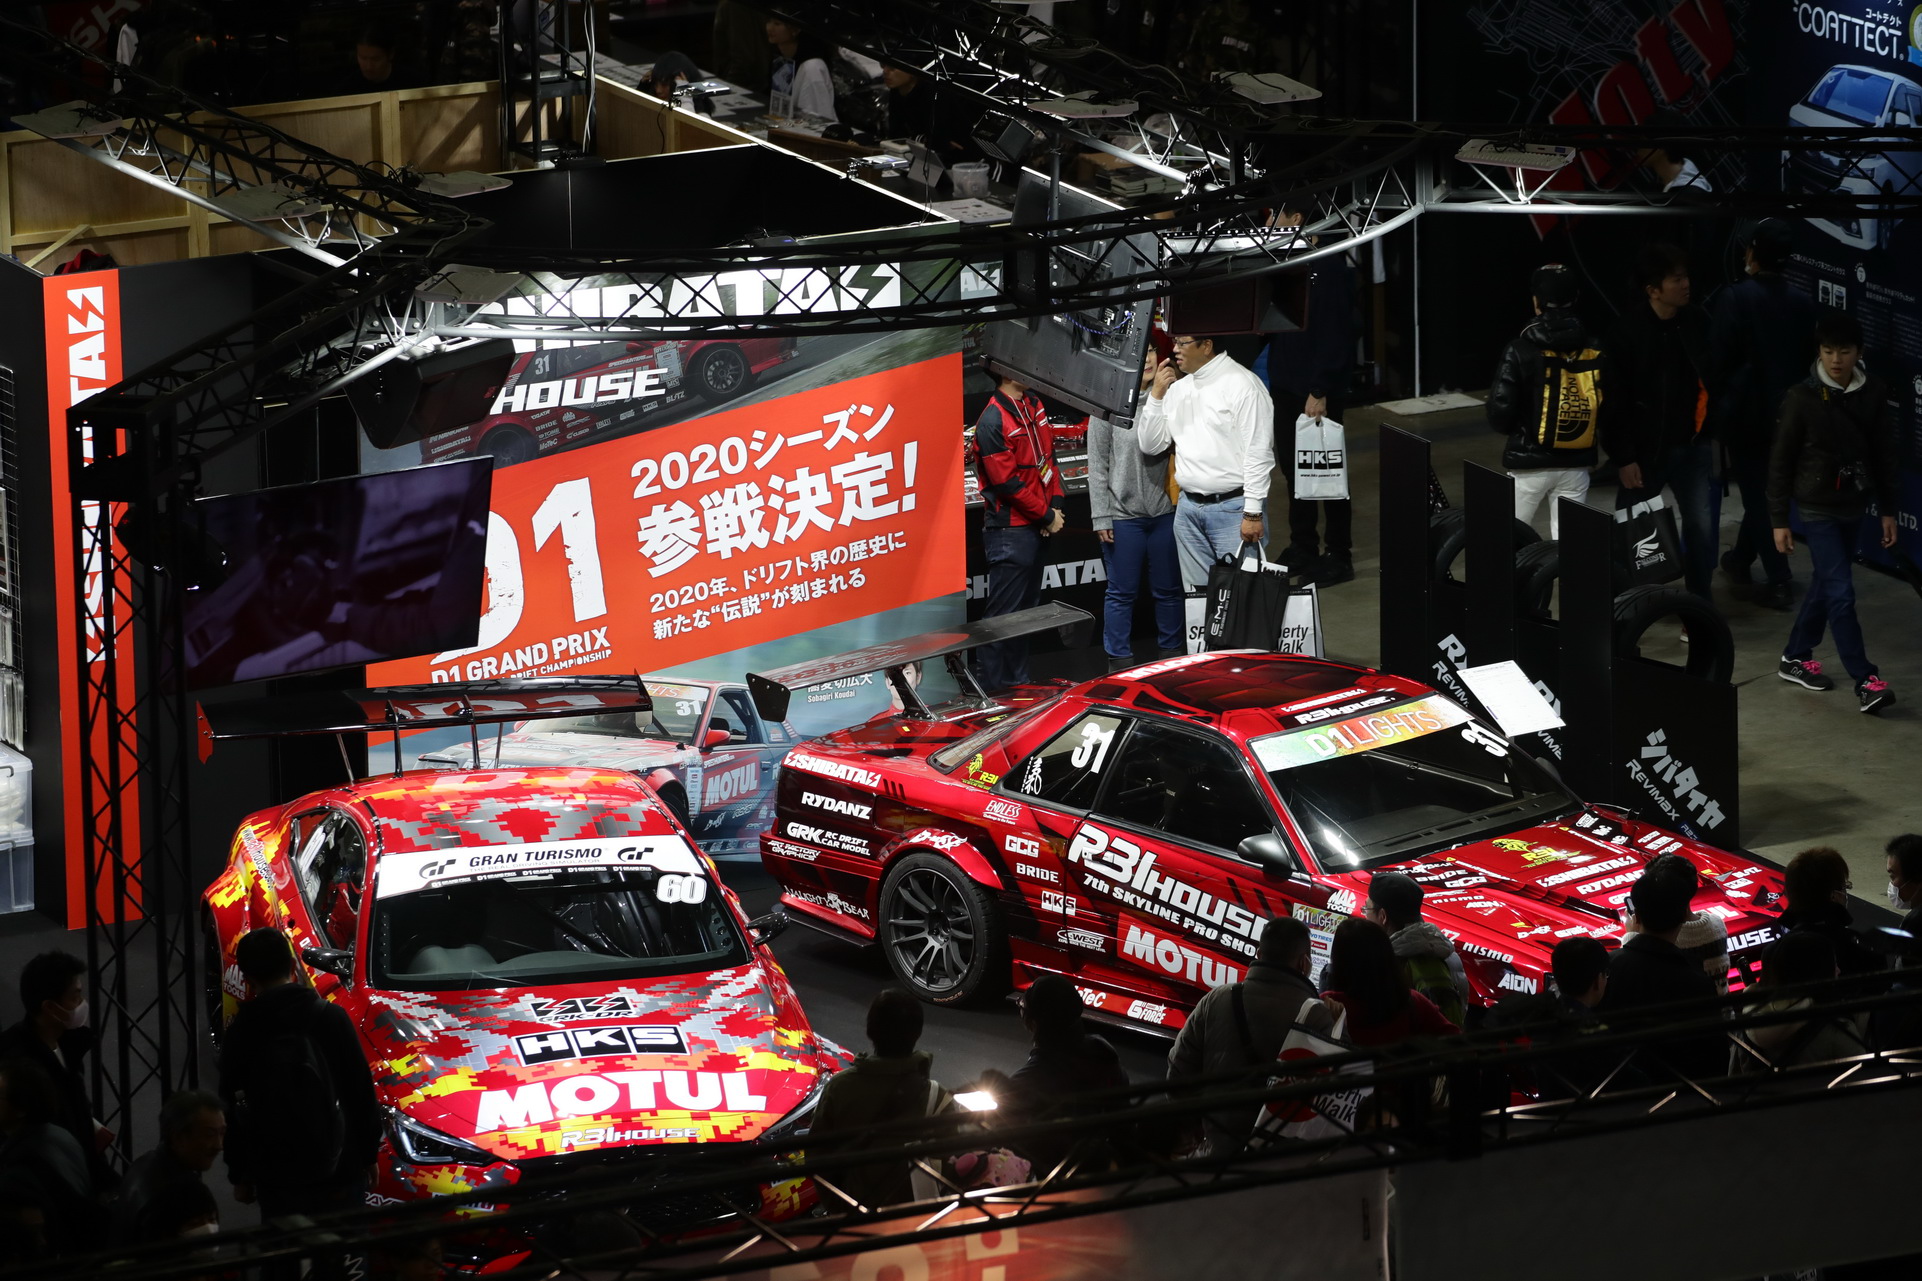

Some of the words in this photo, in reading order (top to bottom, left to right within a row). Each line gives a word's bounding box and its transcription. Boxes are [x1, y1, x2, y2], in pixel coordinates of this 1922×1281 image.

[1865, 8, 1902, 27] コートテクト
[535, 354, 550, 375] 31
[1560, 386, 1572, 419] FACE
[1568, 377, 1580, 420] NORTH
[1580, 396, 1591, 420] THE
[632, 403, 895, 499] 2020シーズン
[1298, 450, 1343, 467] HKS
[650, 530, 908, 614] 2020年、ドリフト界の歴史に
[431, 665, 461, 684] D1
[466, 643, 549, 682] GRAND
[552, 626, 612, 660] PRIX
[540, 649, 612, 675] CHAMPIONSHIP
[675, 699, 702, 716] 31
[807, 692, 832, 704] Sobagiri
[834, 689, 855, 700] Koudai
[1070, 722, 1116, 774] 31
[704, 762, 757, 807] MOTUL
[801, 791, 873, 820] RYDANZ
[985, 800, 1023, 818] ENDLESS
[787, 821, 826, 845] GRK
[825, 831, 838, 841] RC
[838, 834, 869, 848] DRIFT
[1005, 834, 1040, 858] GCG
[469, 852, 519, 868] GRAN
[524, 847, 603, 862] TURISMO
[820, 838, 840, 849] CAR
[841, 844, 871, 856] MODEL
[1016, 862, 1059, 884] BRIDE
[1415, 867, 1470, 882] BRIDE
[1444, 876, 1487, 888] GCG
[1041, 890, 1077, 916] HKS
[1327, 902, 1354, 915] TOOLS
[1328, 889, 1357, 909] MAC
[1083, 873, 1110, 894] 7th
[1112, 886, 1181, 925] SKYLINE
[1182, 917, 1219, 940] PRO
[1220, 933, 1259, 960] SHO
[1462, 942, 1514, 964] nismo
[224, 981, 246, 1001] TOOLS
[1497, 973, 1537, 995] AION
[520, 1027, 680, 1057] HKS
[474, 1070, 767, 1133] MOTUL
[560, 1126, 703, 1149] R31HOUSE
